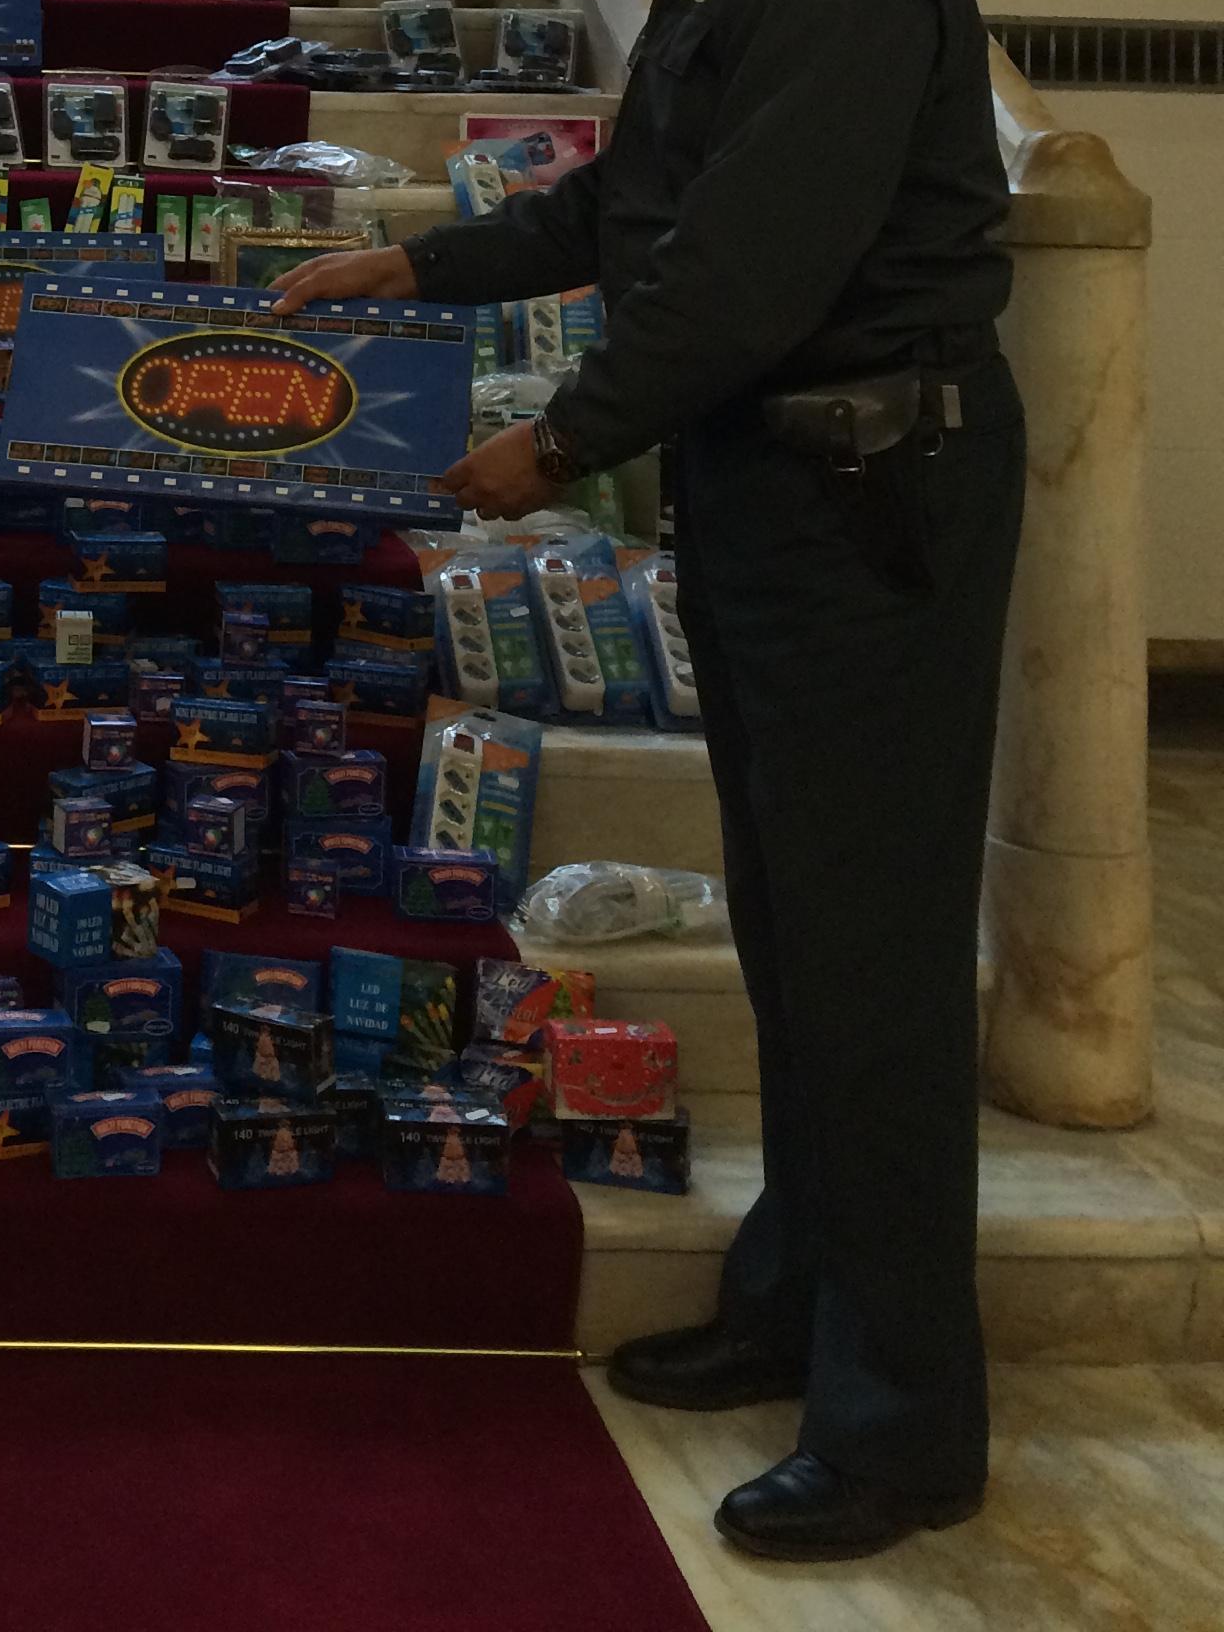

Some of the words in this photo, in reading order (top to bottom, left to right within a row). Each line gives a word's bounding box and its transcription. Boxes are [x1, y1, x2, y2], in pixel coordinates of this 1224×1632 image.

[130, 356, 338, 428] OPEN
[346, 1014, 389, 1031] NAVIDAD
[233, 1129, 253, 1141] 140
[400, 1131, 421, 1144] 140
